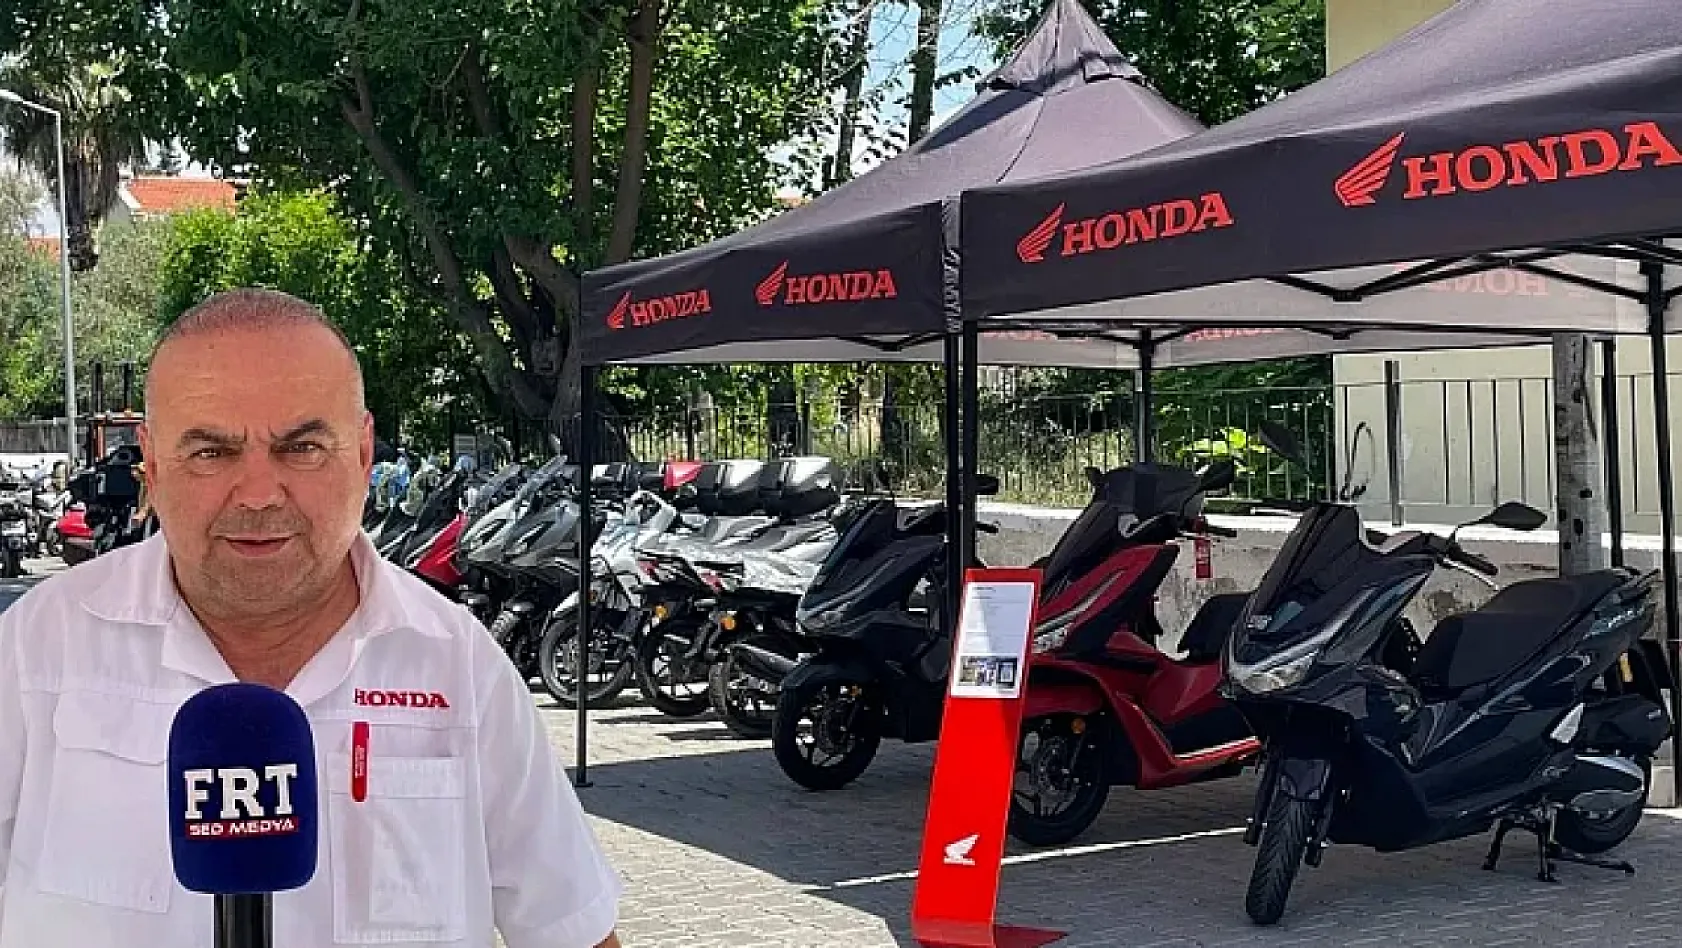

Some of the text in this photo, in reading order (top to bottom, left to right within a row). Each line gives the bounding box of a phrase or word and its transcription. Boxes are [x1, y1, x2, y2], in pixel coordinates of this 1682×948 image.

[1403, 121, 1682, 199] HONDA
[1061, 193, 1234, 256] HONDA
[784, 270, 898, 304] HONDA
[353, 688, 450, 708] HONDA
[184, 763, 298, 819] FRT
